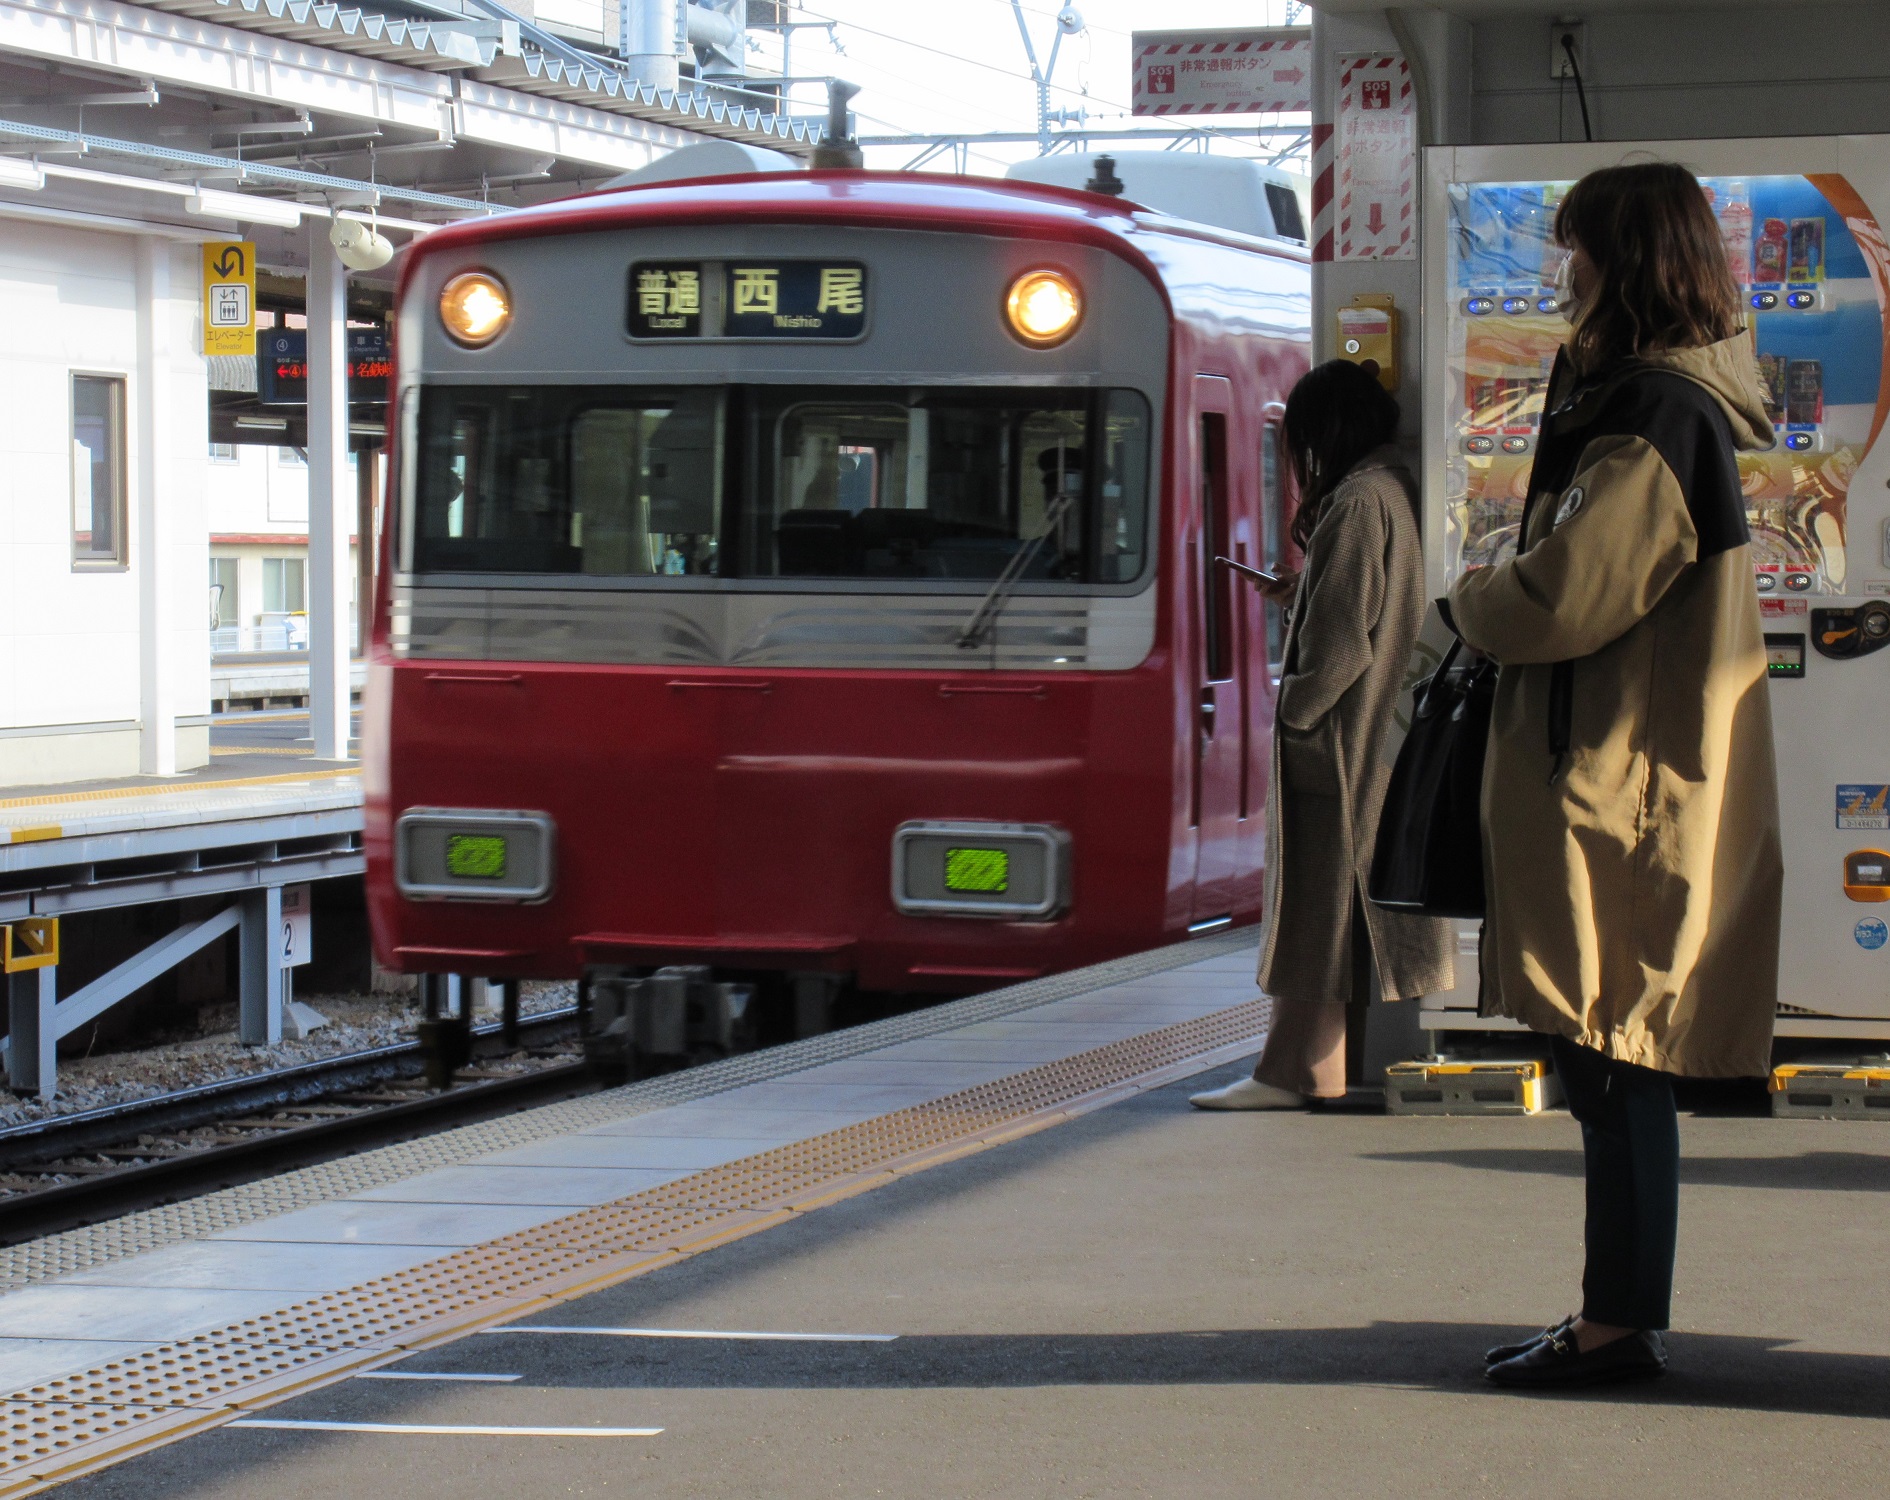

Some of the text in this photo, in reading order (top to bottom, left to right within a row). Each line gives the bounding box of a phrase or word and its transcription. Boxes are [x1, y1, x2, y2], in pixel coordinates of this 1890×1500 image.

[1179, 57, 1272, 73] 非常通報ボタン
[1150, 66, 1173, 76] SOS
[1200, 80, 1243, 89] Emergency
[1364, 81, 1389, 91] SOS
[636, 270, 701, 315] 普通
[206, 330, 252, 341] エレベーター
[1512, 439, 1525, 447] 130
[284, 922, 292, 956] 2
